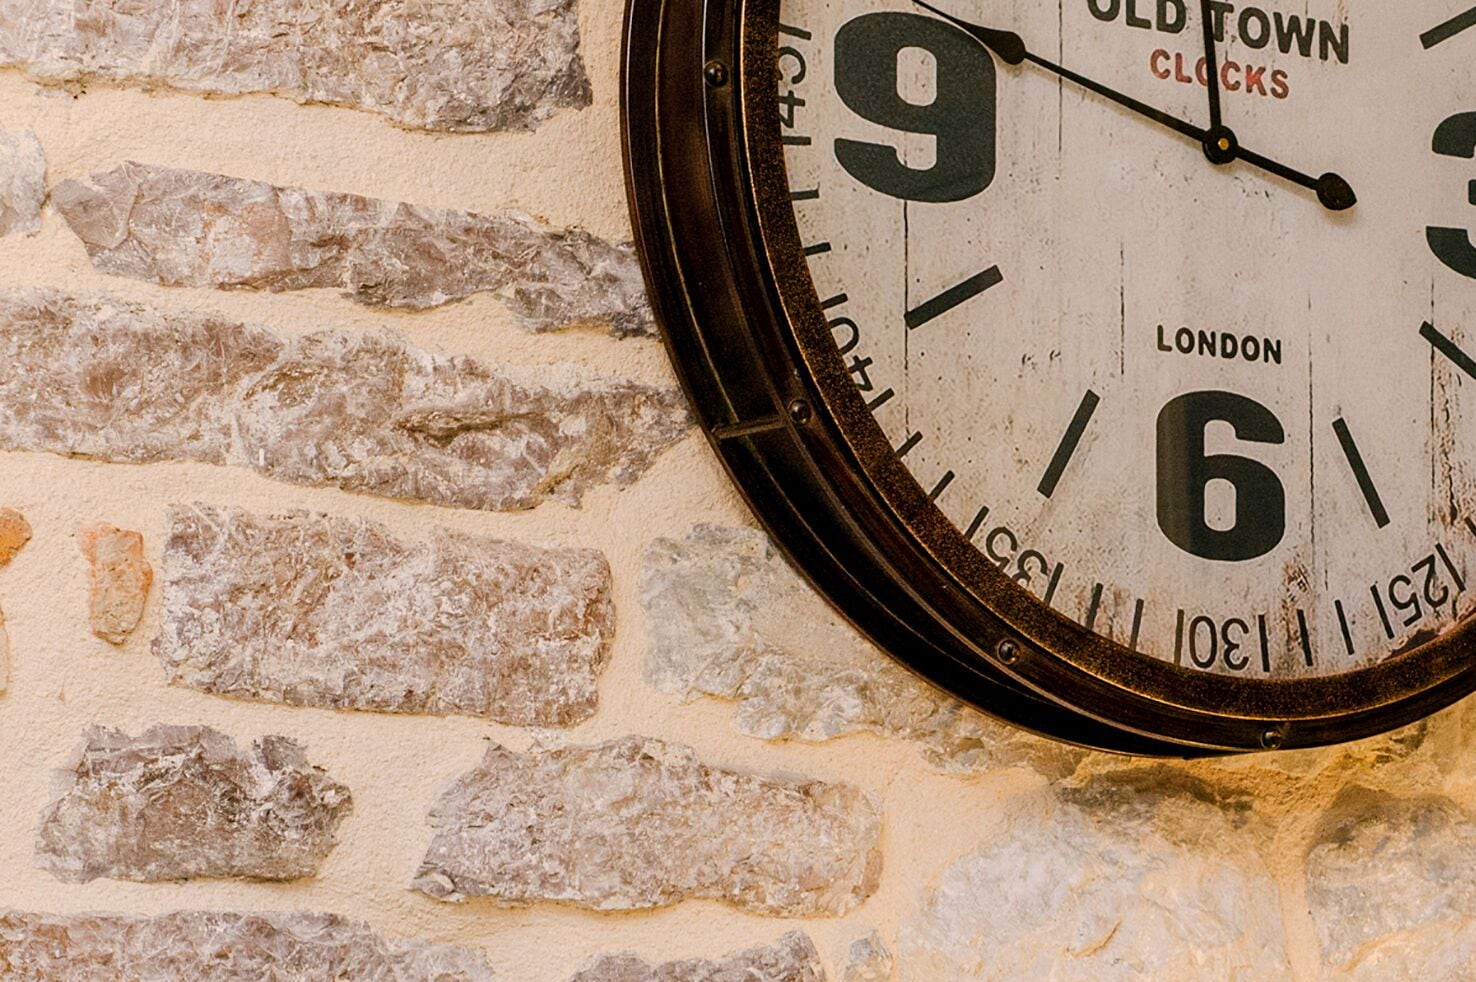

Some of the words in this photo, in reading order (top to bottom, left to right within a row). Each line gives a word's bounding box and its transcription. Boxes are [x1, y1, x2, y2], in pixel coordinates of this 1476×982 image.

[1209, 1, 1350, 65] TOWN
[833, 11, 997, 203] 9
[1156, 324, 1282, 365] LONDON
[1155, 389, 1286, 562] 6
[1387, 553, 1450, 628] 25
[1188, 614, 1250, 672] 30
